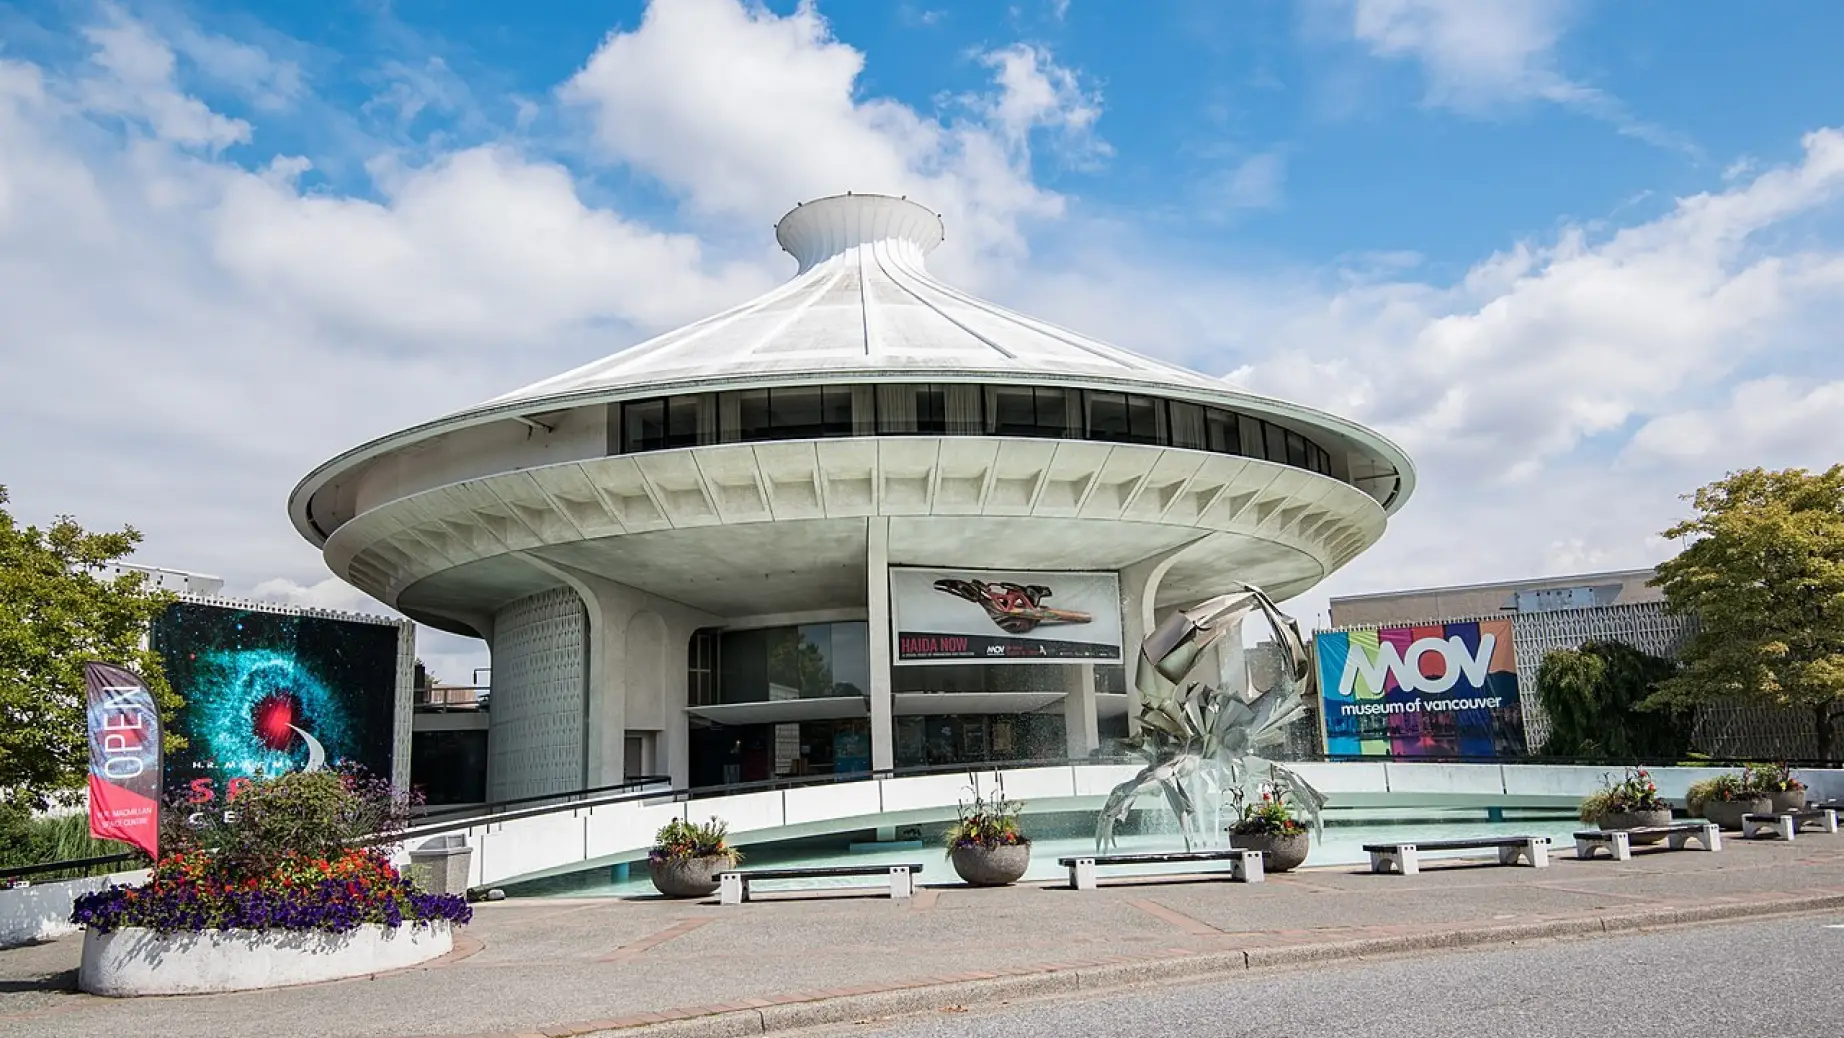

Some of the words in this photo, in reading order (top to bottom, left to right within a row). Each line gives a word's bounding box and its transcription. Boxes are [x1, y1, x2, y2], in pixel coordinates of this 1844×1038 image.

[901, 638, 937, 653] HAIDA
[940, 637, 968, 652] NOW
[986, 644, 1005, 653] MOV
[1338, 633, 1497, 695] MOV
[1341, 701, 1403, 716] museum
[1406, 699, 1421, 712] of
[1423, 696, 1502, 711] vancouver
[103, 686, 143, 779] OPEN
